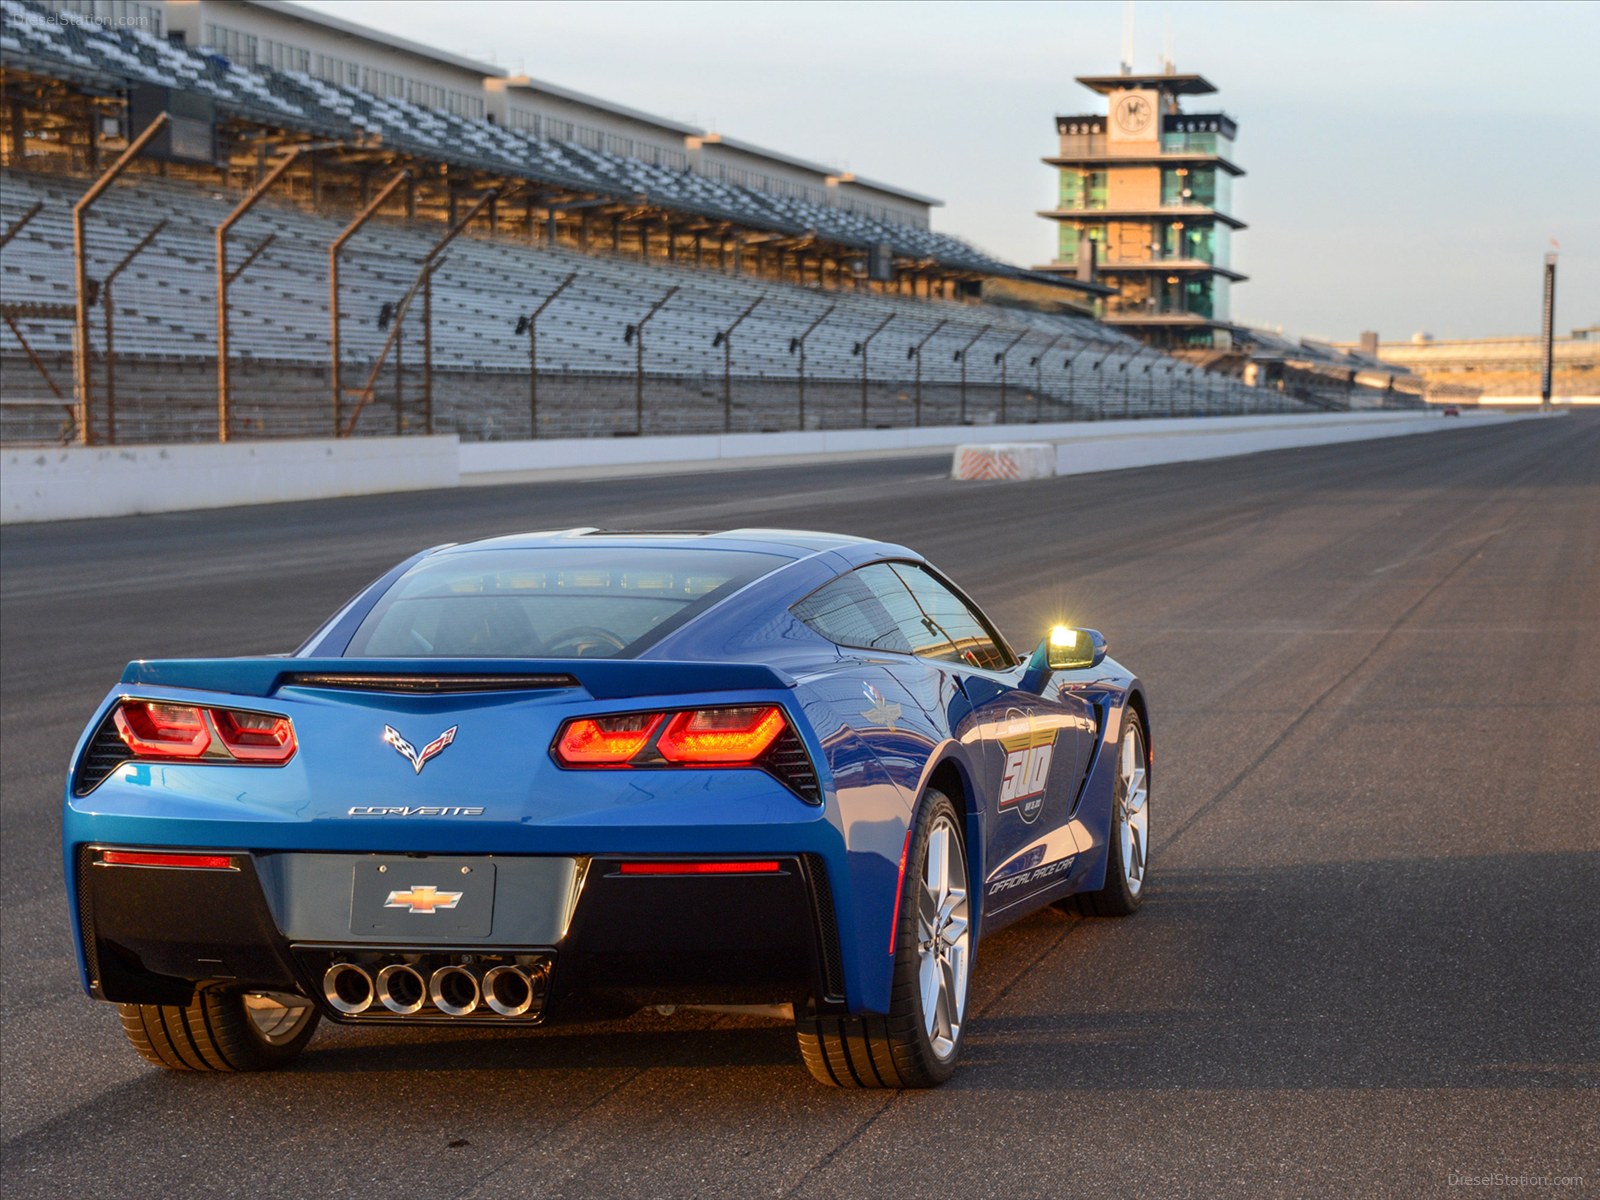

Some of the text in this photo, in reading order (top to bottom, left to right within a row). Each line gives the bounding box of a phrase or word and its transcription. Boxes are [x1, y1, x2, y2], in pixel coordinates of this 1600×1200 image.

[1001, 745, 1052, 802] 500
[347, 805, 485, 817] CORVETTE
[988, 857, 1075, 896] OFFICIAL PACE CAR
